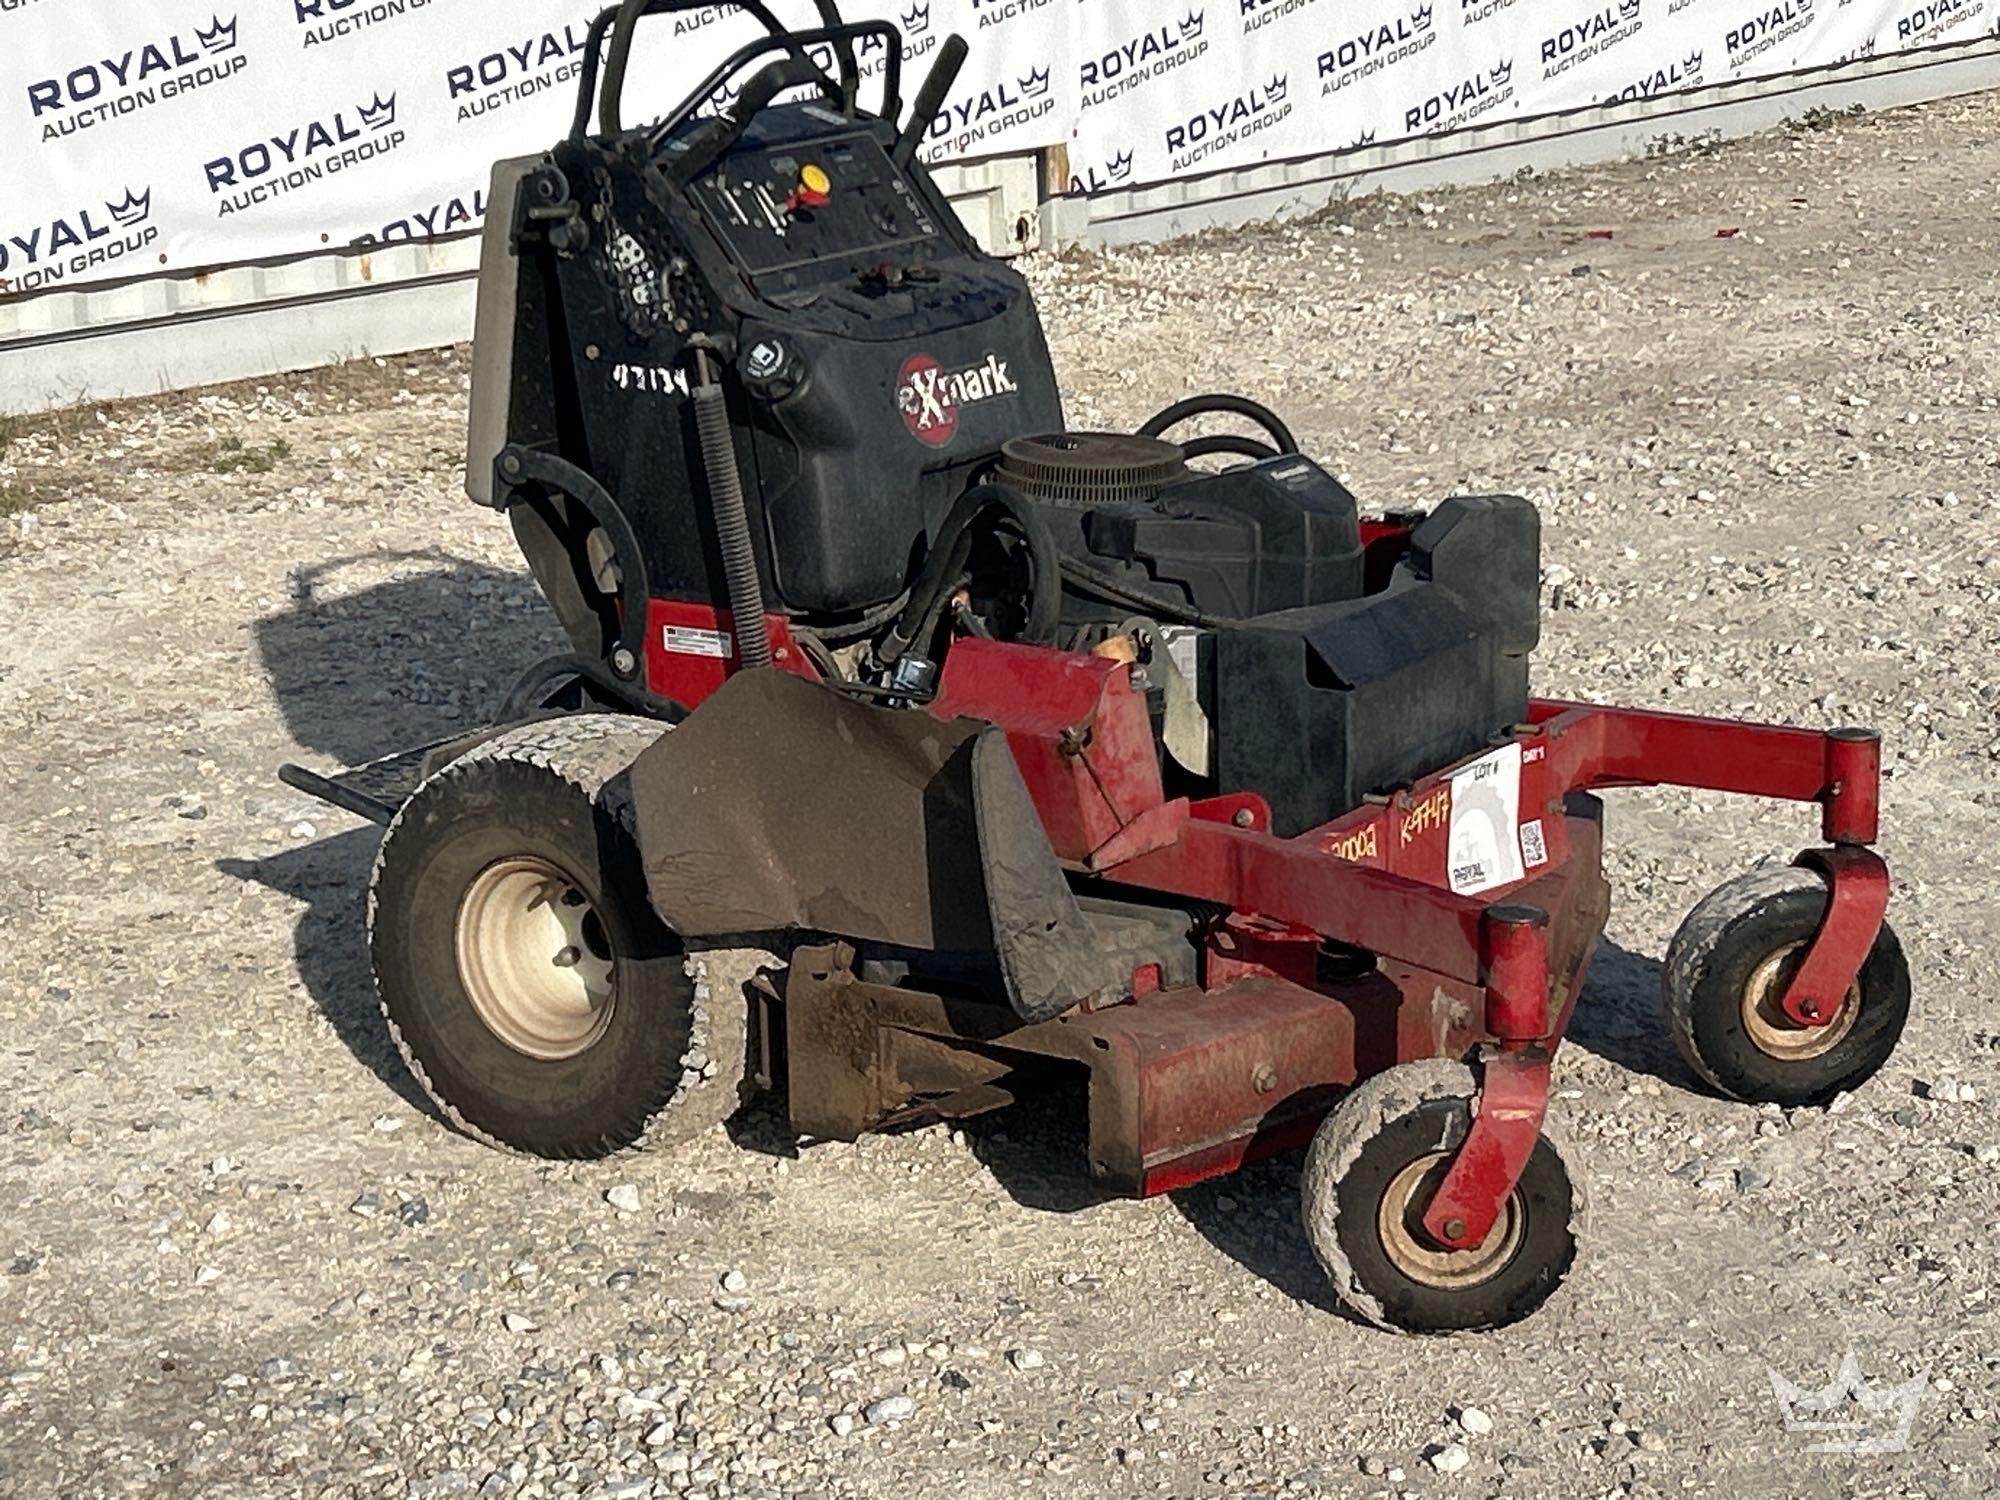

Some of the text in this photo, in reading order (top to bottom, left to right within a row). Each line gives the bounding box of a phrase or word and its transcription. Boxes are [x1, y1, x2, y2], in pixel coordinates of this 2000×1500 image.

[1080, 26, 1180, 90] ROYAL
[1317, 18, 1412, 79] ROYAL
[1541, 7, 1619, 64] ROYAL
[1542, 21, 1643, 81] AUCTION GROUP
[1725, 1, 1796, 54] ROYAL
[1729, 13, 1815, 70] AUCTION GROUP
[27, 35, 200, 118] ROYAL
[446, 24, 587, 99] ROYAL
[1080, 40, 1209, 111] AUCTION GROUP
[1321, 31, 1436, 98] AUCTION GROUP
[41, 54, 248, 143] AUCTION GROUP
[457, 73, 552, 123] AUCTION
[922, 83, 1019, 143] OYAL
[988, 98, 1055, 135] GROUP
[1166, 89, 1267, 154] ROYAL
[1405, 73, 1490, 133] ROYAL
[1469, 86, 1514, 119] GROUP
[203, 113, 361, 193] ROYAL
[1171, 102, 1293, 173] AUCTION GROUP
[217, 130, 406, 218] AUCTION GROUP
[70, 226, 158, 274] GROUP
